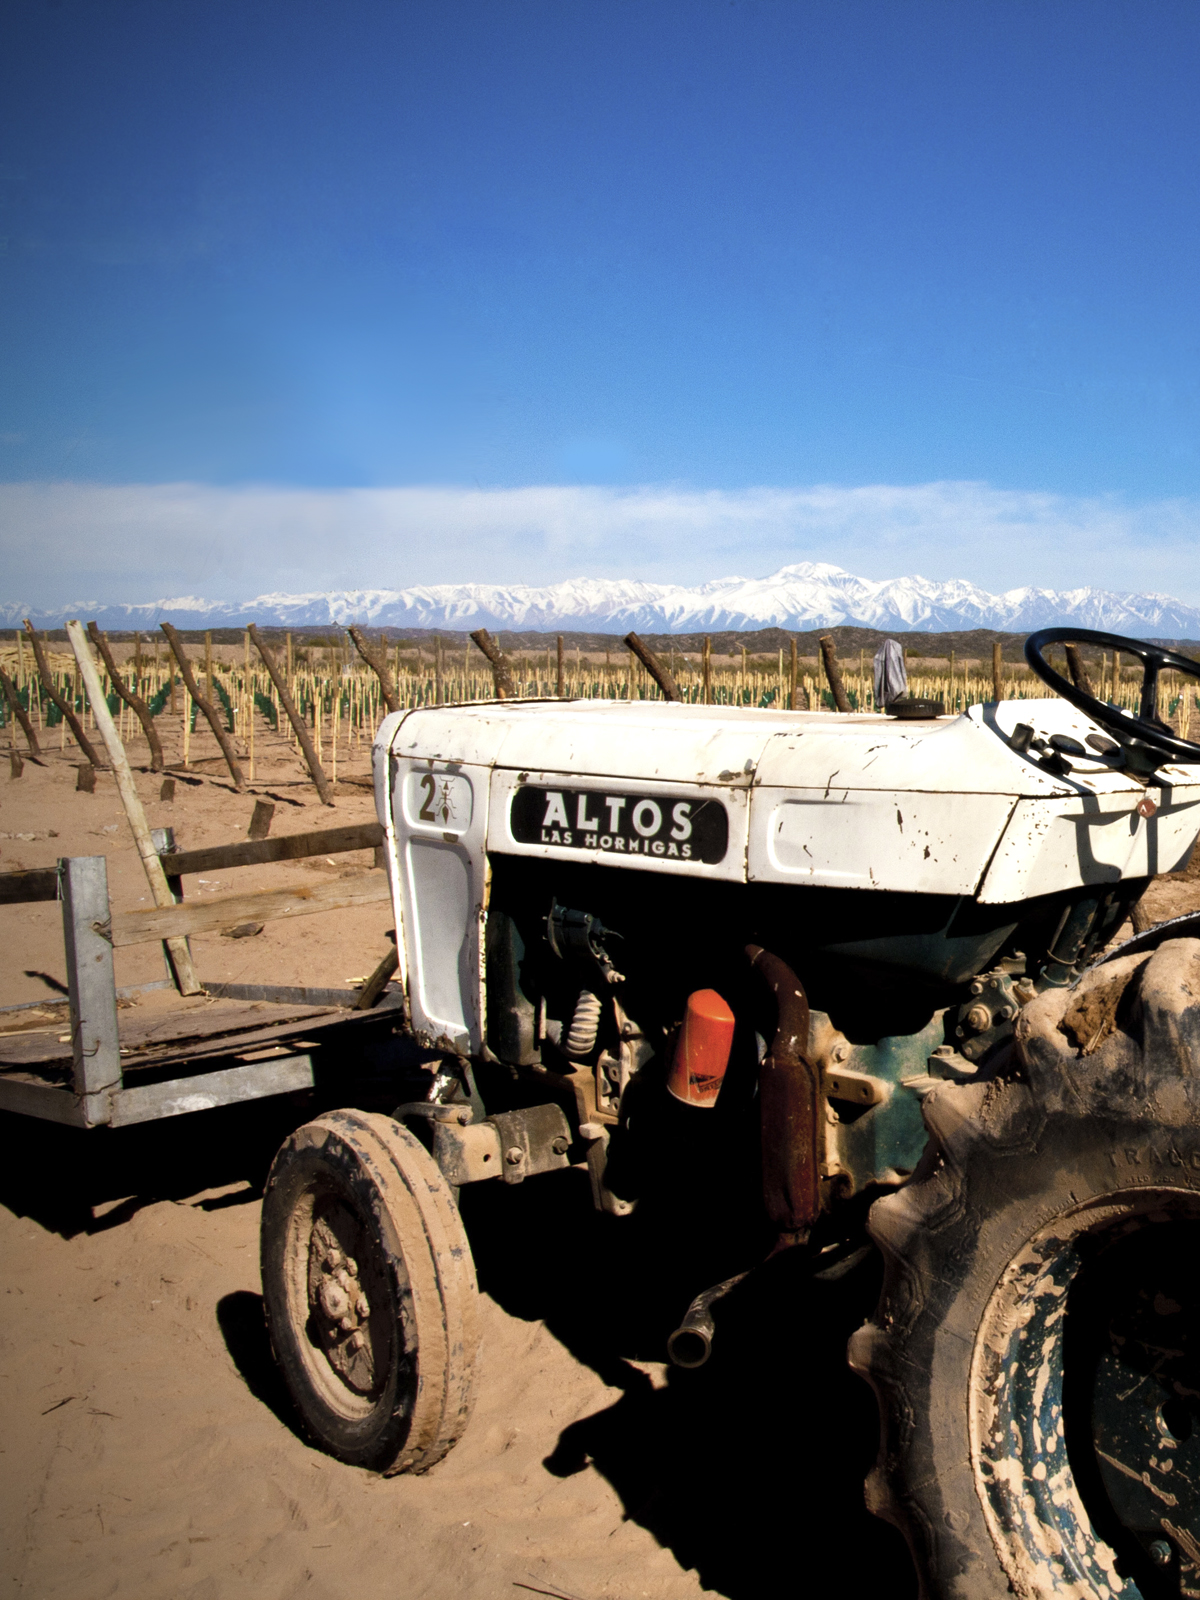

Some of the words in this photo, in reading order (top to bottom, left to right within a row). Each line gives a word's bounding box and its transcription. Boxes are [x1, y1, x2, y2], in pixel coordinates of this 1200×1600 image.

[419, 774, 437, 822] 2
[542, 791, 693, 841] ALTOS
[541, 828, 574, 845] LAS
[585, 833, 693, 858] HORMIGAS
